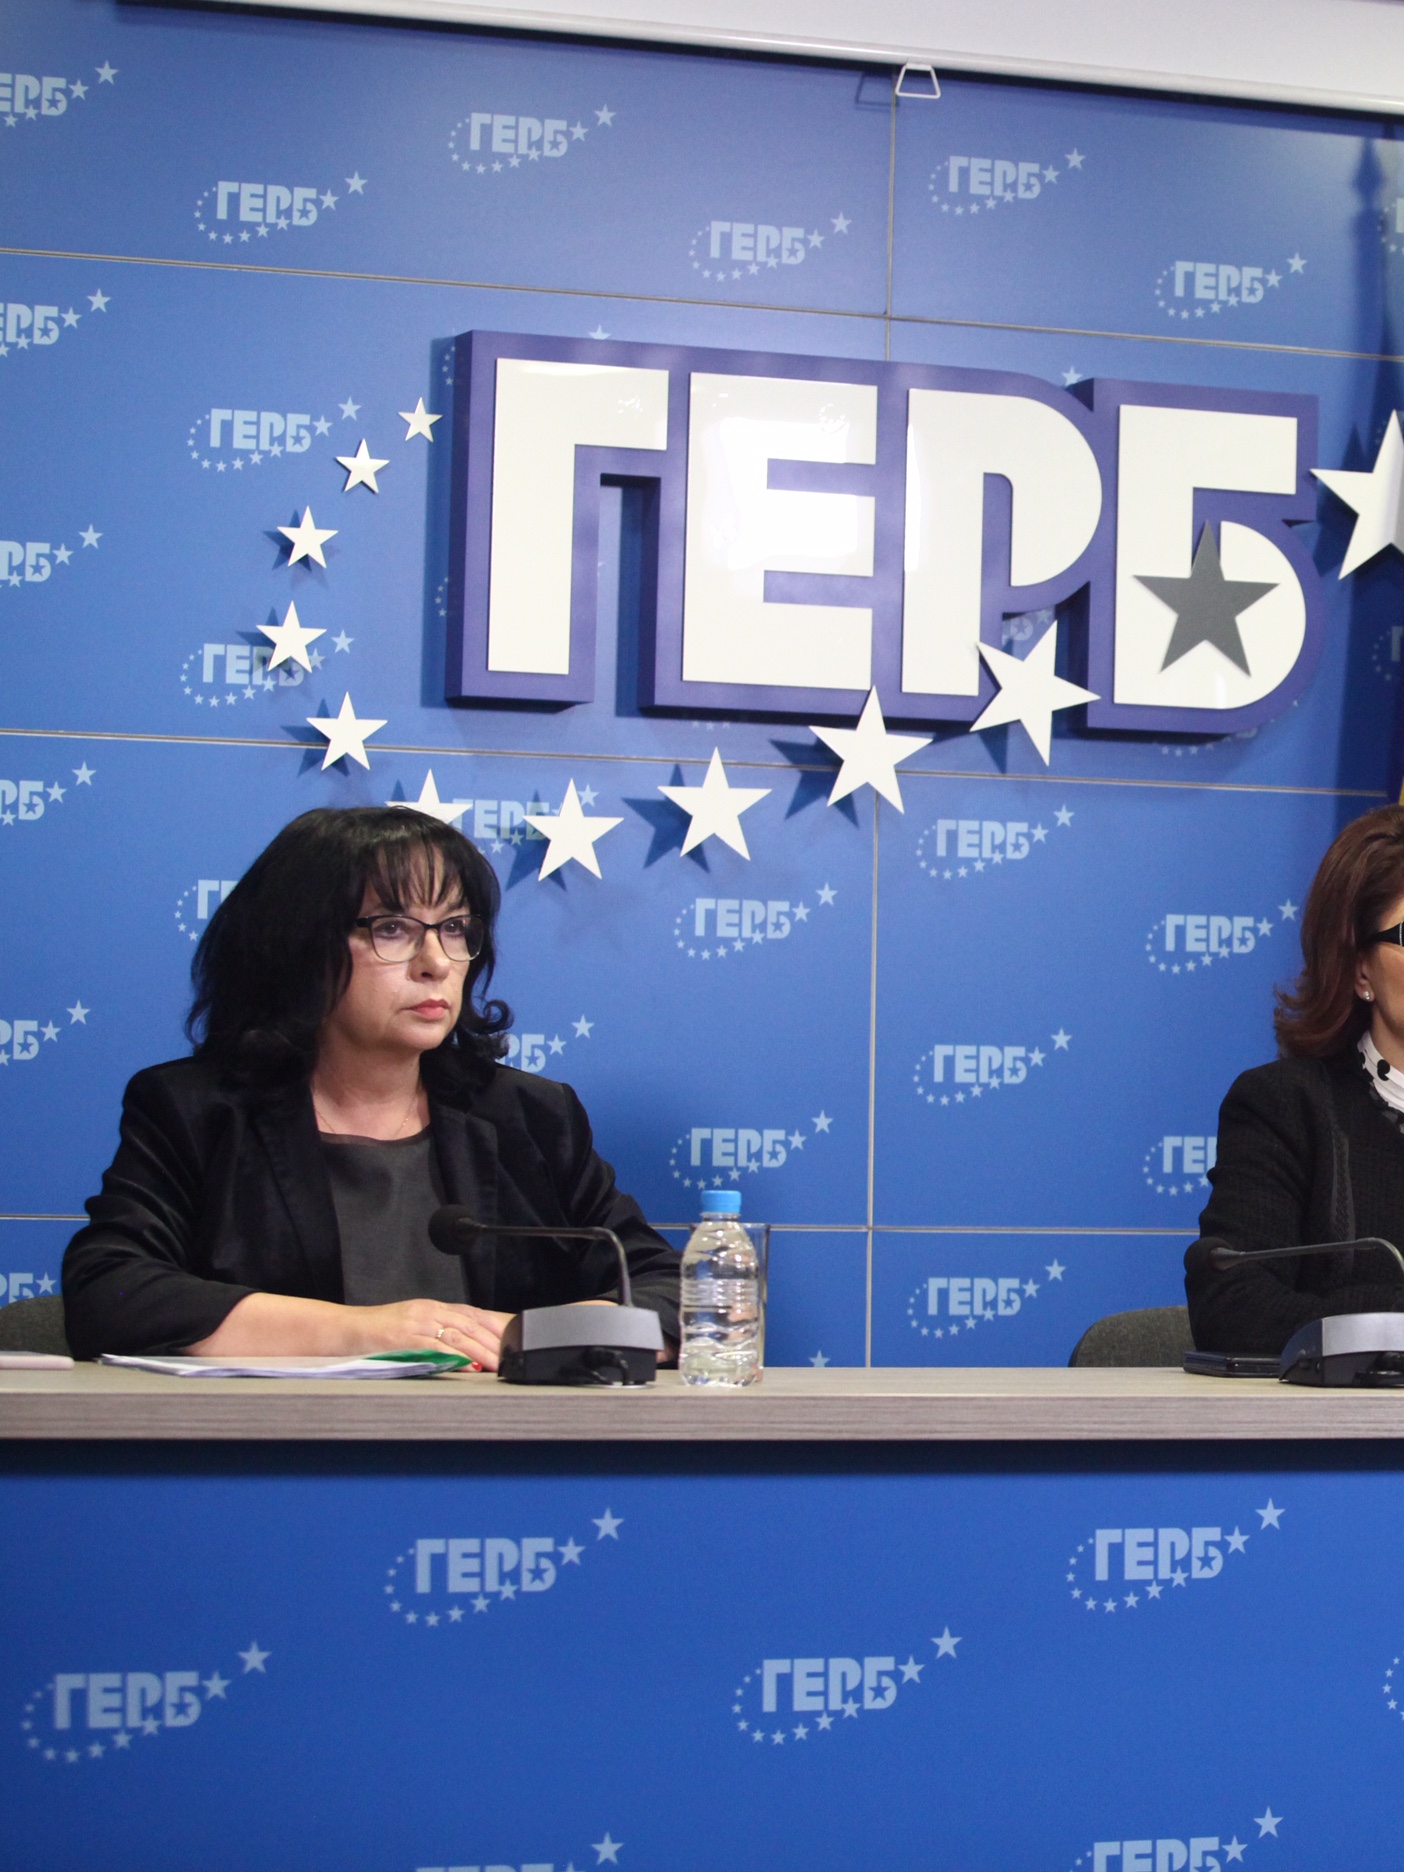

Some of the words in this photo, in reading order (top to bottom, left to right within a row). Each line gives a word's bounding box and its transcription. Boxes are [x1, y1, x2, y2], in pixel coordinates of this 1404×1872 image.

[469, 112, 568, 158] ГЕРБ
[947, 156, 1041, 200] ГЕРБ
[216, 181, 318, 227] ГЕРБ
[709, 221, 805, 266] ГЕРБ
[1173, 261, 1264, 304] ГЕРБ
[210, 409, 311, 453] ГЕРБ
[487, 357, 1308, 710] ГЕРБ
[936, 819, 1030, 860] ГЕРБ
[694, 898, 792, 940] ГЕРБ
[1164, 914, 1256, 954] ГЕРБ
[933, 1044, 1027, 1085] ГЕРБ
[689, 1127, 786, 1168] ГЕРБ
[926, 1278, 1021, 1315] ГЕРБ
[416, 1538, 557, 1593] ГЕРБ
[1094, 1527, 1223, 1580] ГЕРБ
[54, 1672, 200, 1729] ГЕРБ
[762, 1656, 897, 1712] ГЕРБ
